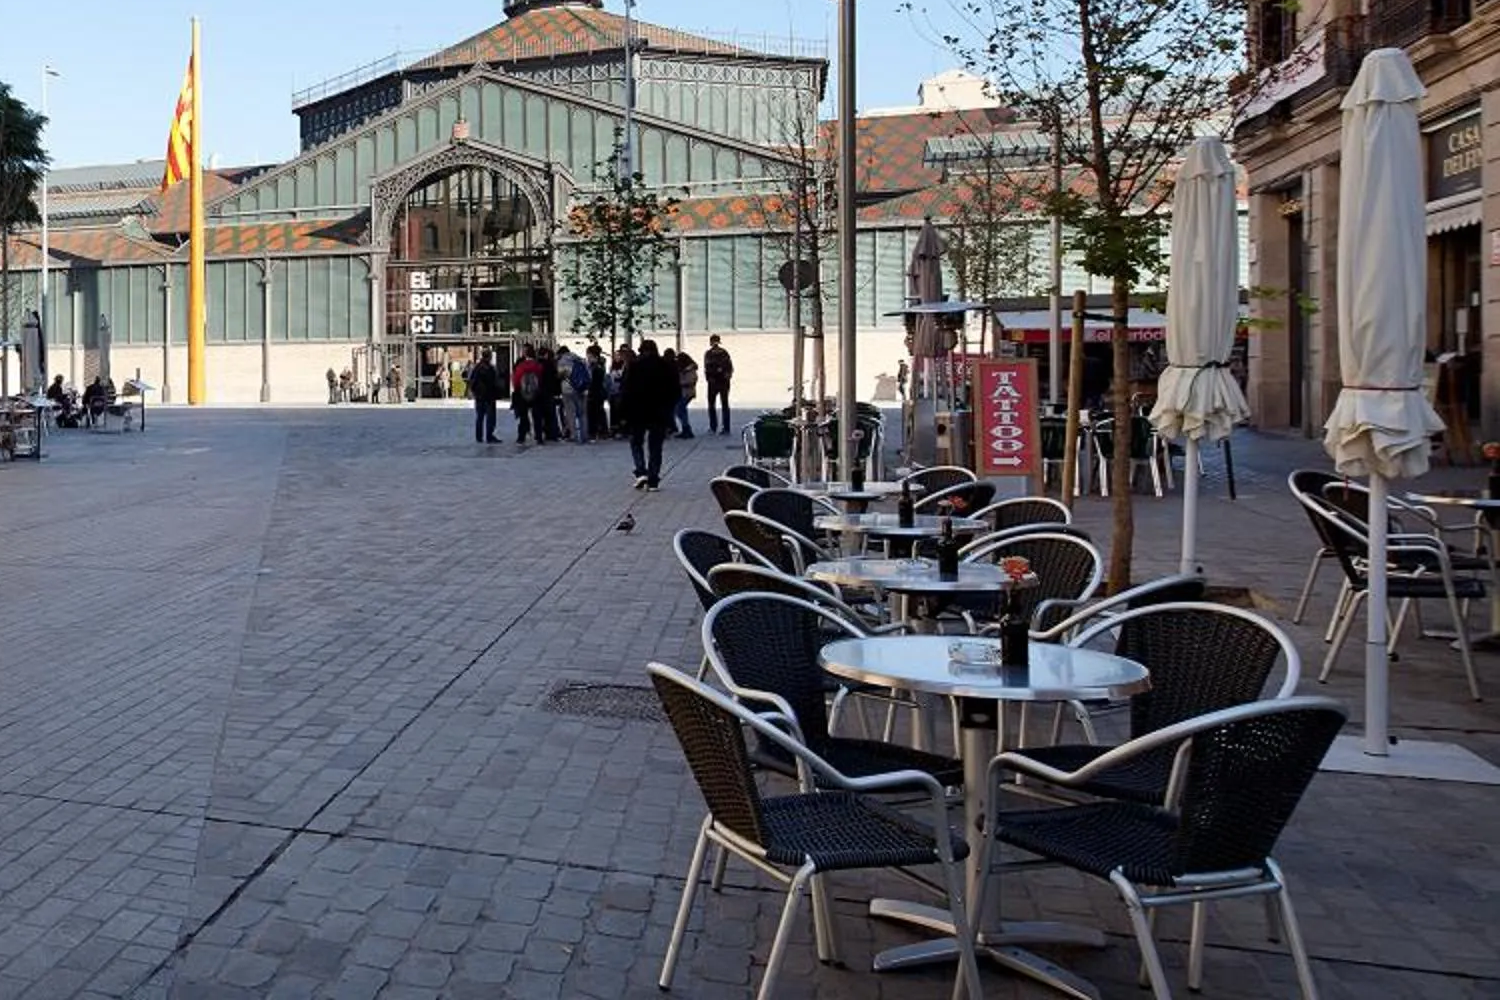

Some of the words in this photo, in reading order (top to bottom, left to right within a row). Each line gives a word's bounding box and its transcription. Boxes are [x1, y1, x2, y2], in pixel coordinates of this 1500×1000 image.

[1449, 125, 1480, 152] CASA
[410, 271, 431, 289] EL
[411, 292, 457, 311] BORN
[410, 315, 433, 334] CC
[989, 371, 1024, 452] TATTOO
